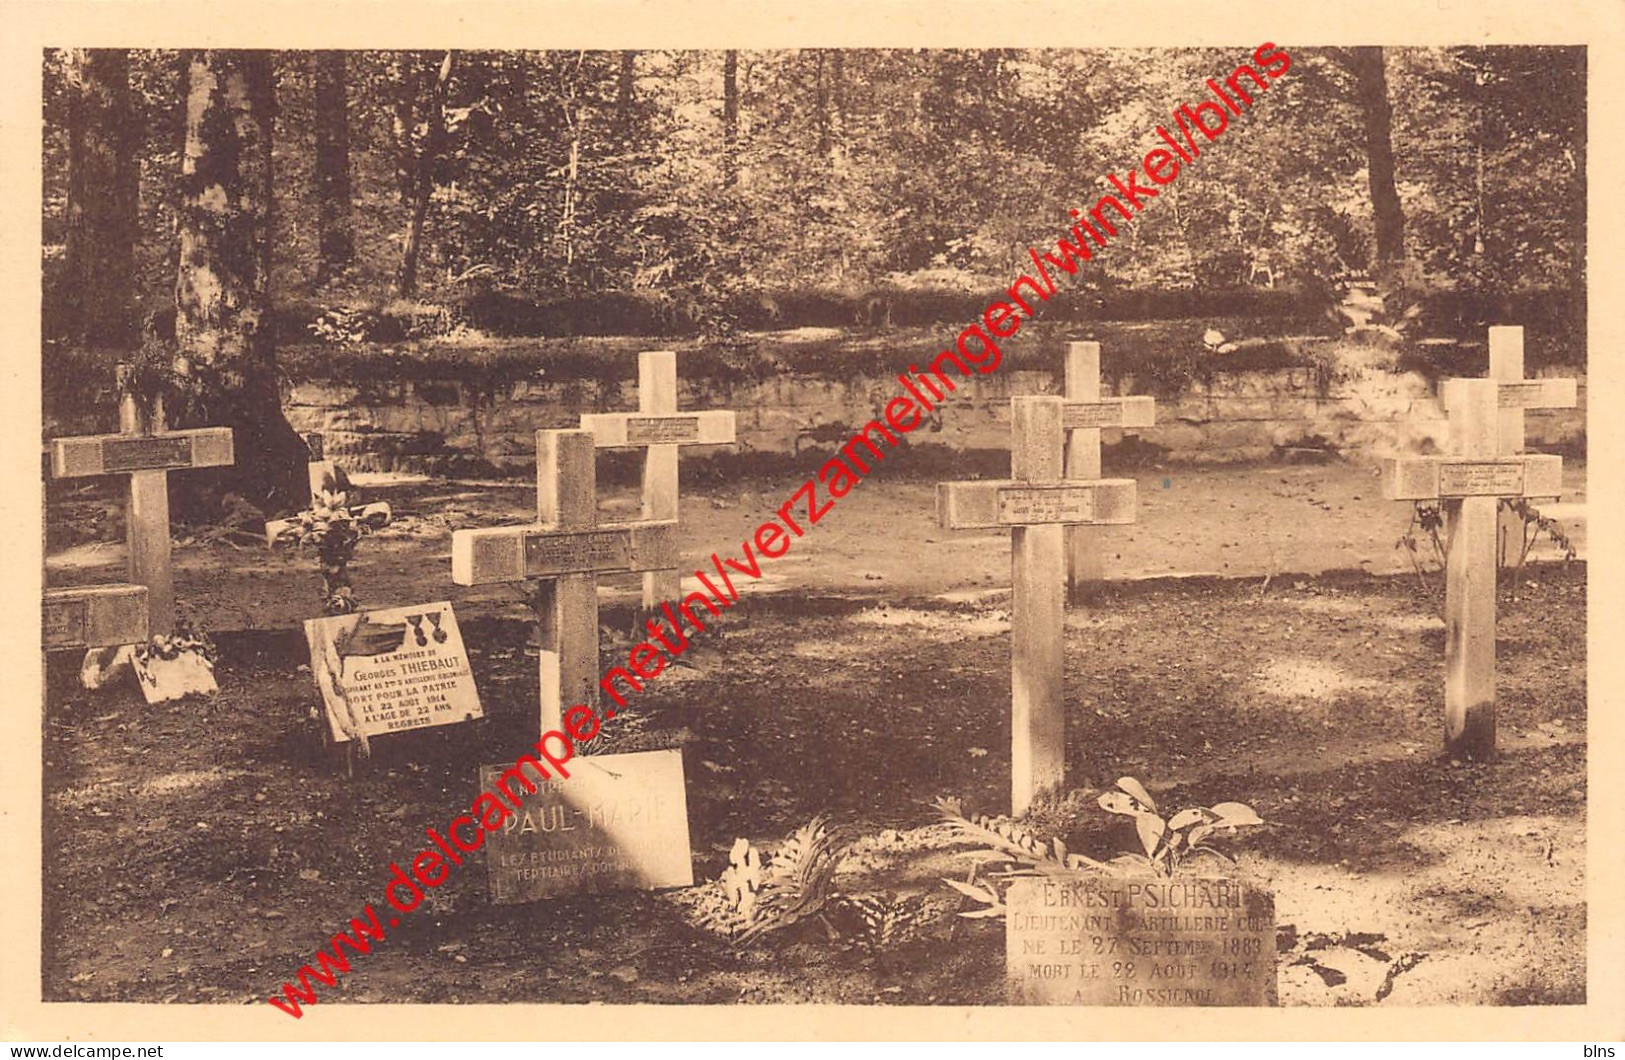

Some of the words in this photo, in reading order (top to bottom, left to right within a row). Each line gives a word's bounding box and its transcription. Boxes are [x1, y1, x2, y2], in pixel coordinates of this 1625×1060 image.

[376, 691, 403, 701] POUR
[406, 687, 420, 696] LA
[422, 681, 458, 694] PATRIE
[363, 705, 374, 713] LE
[380, 702, 394, 710] 22
[399, 709, 412, 718] DE
[416, 706, 430, 716] 22
[434, 703, 453, 713] ANS
[1043, 883, 1121, 908] ERNEST
[1128, 883, 1241, 909] PSICHARI
[1013, 913, 1111, 931] LIEUTENANT
[1060, 940, 1081, 955] LE
[1092, 936, 1119, 956] 27
[1028, 964, 1072, 979] MORT
[1081, 964, 1100, 979] LE
[1113, 962, 1136, 979] 22
